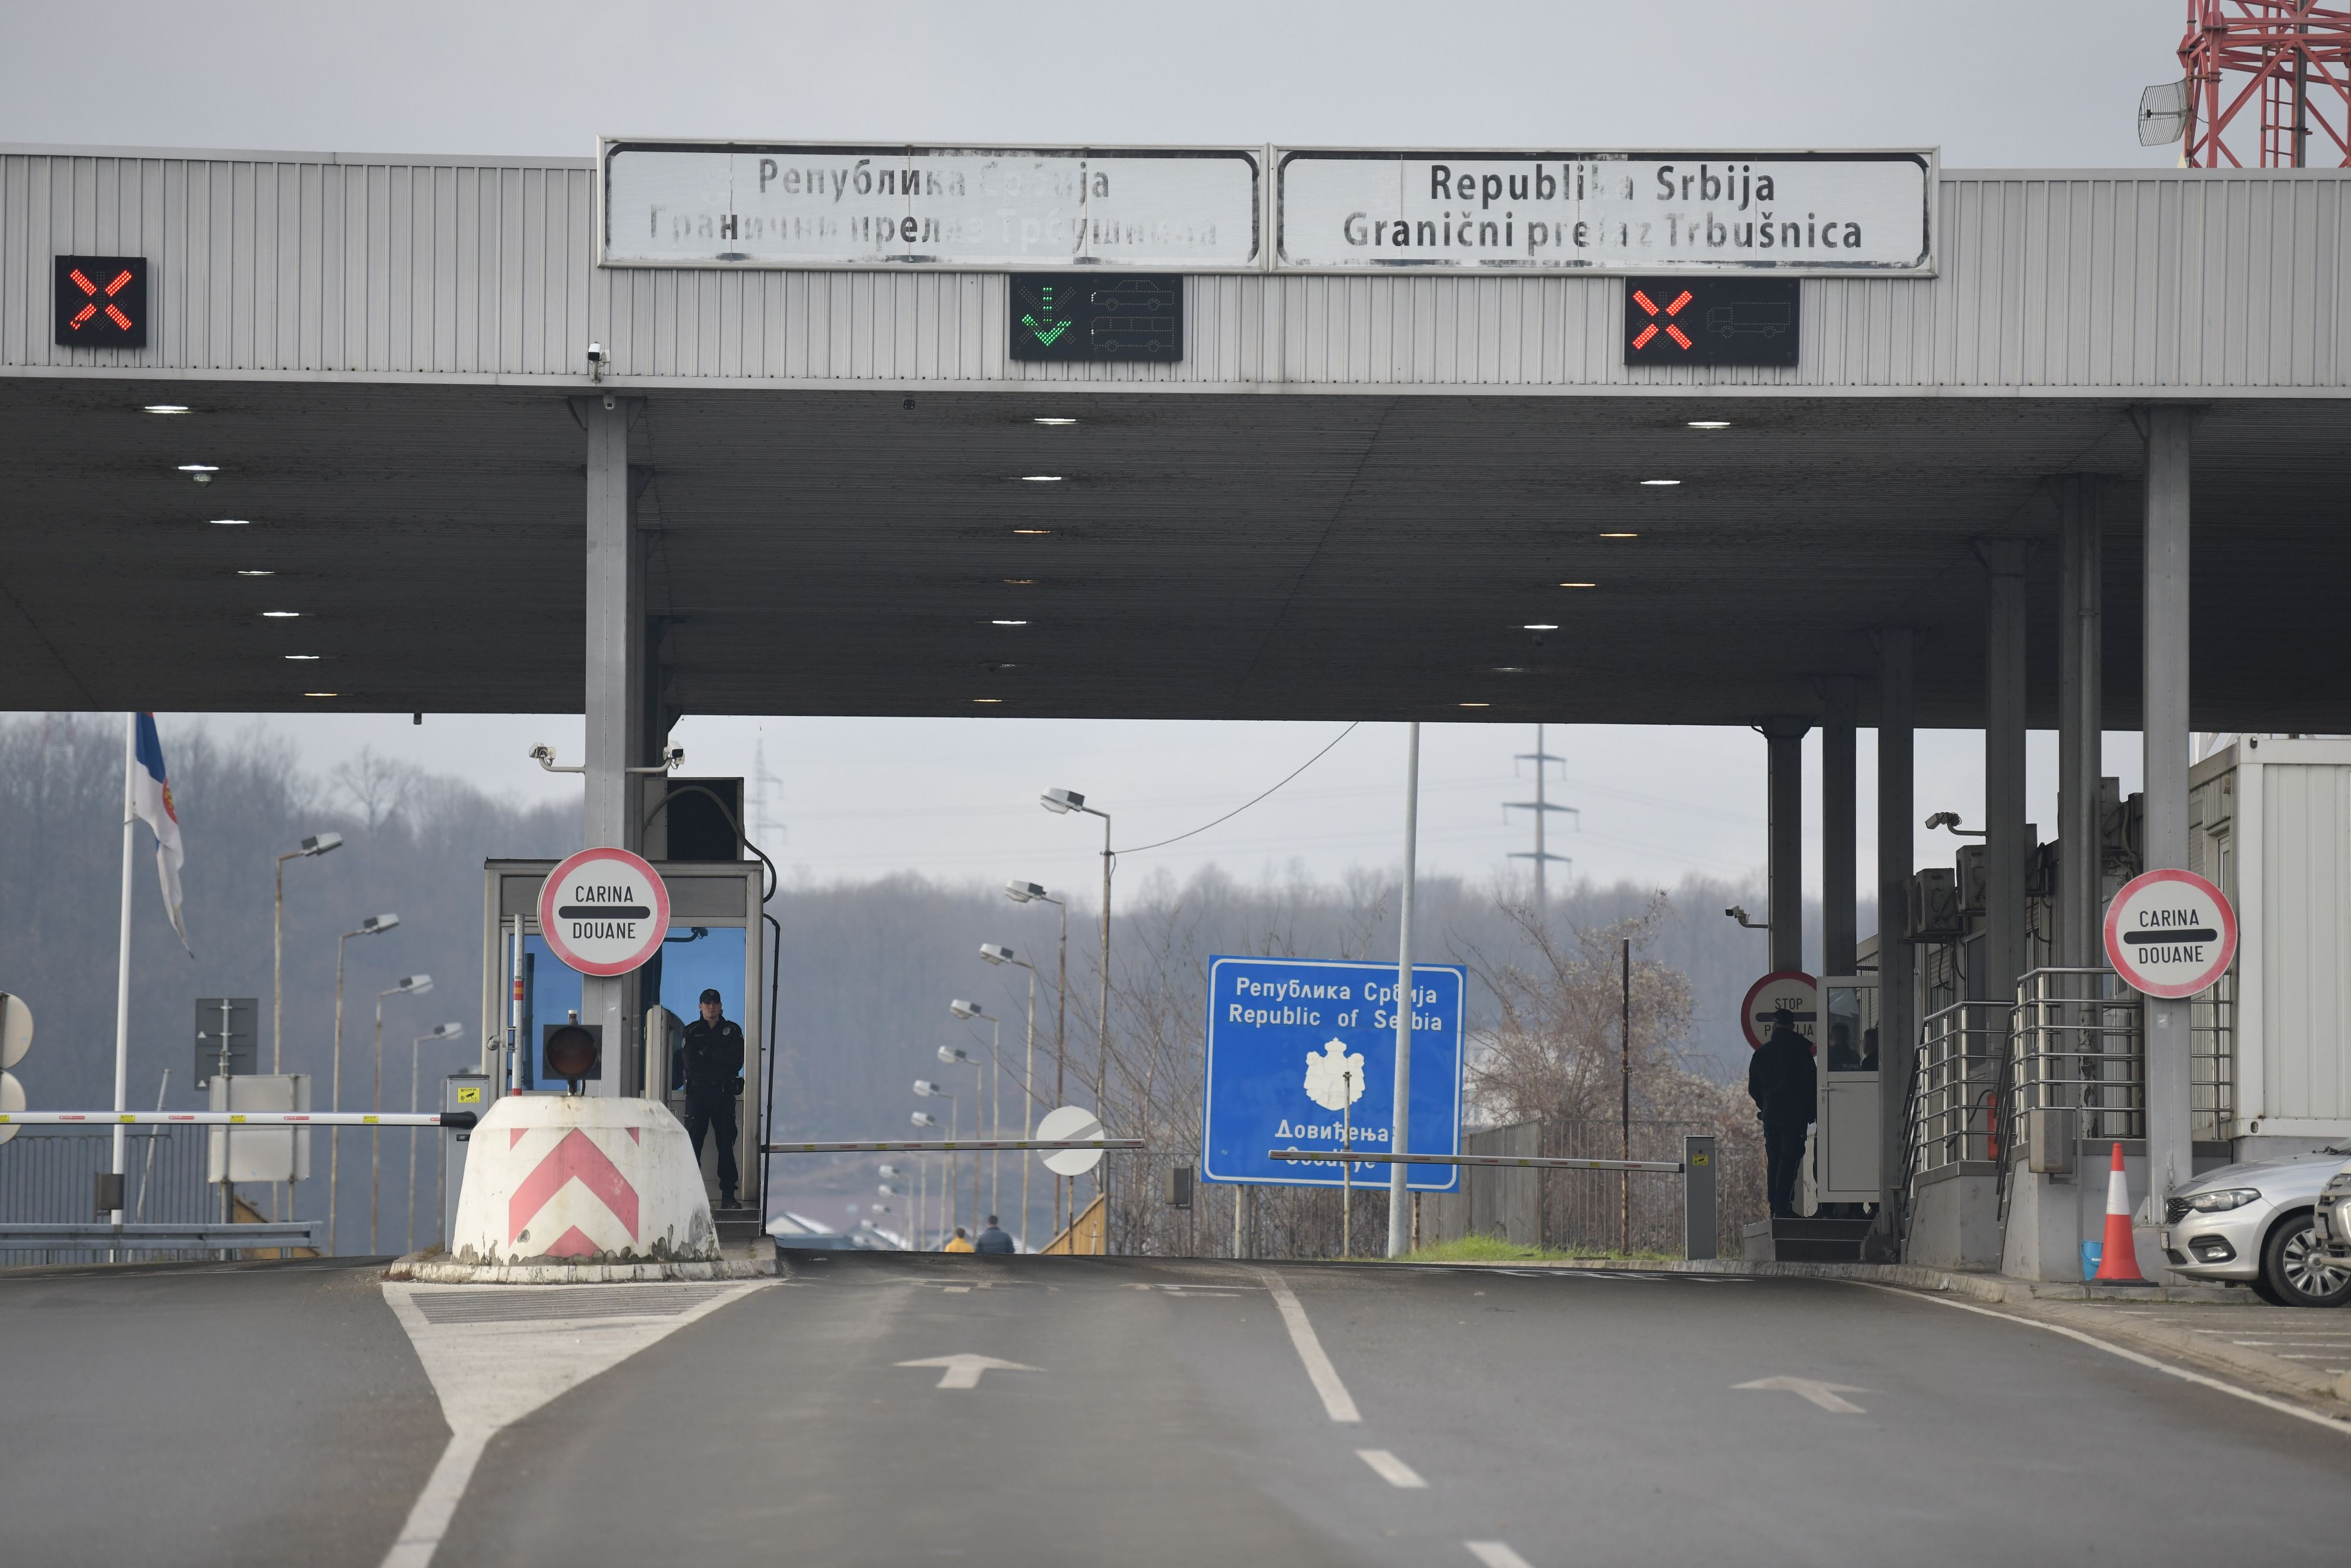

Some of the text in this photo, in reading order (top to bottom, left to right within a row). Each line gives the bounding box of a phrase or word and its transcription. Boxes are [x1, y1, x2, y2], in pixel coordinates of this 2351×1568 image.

[759, 158, 966, 203] Република
[1431, 164, 1774, 210] Republika Srbija
[1344, 210, 1513, 247] Granični
[1665, 211, 1861, 248] Trbušnica
[575, 886, 634, 903] CARINA
[2139, 909, 2199, 927] CARINA
[572, 922, 636, 939] DOUANE
[2139, 945, 2204, 964] DOUANE
[1237, 977, 1351, 1001] Република
[1775, 998, 1803, 1010] STOP
[1229, 1004, 1442, 1031] Republic of Sebia
